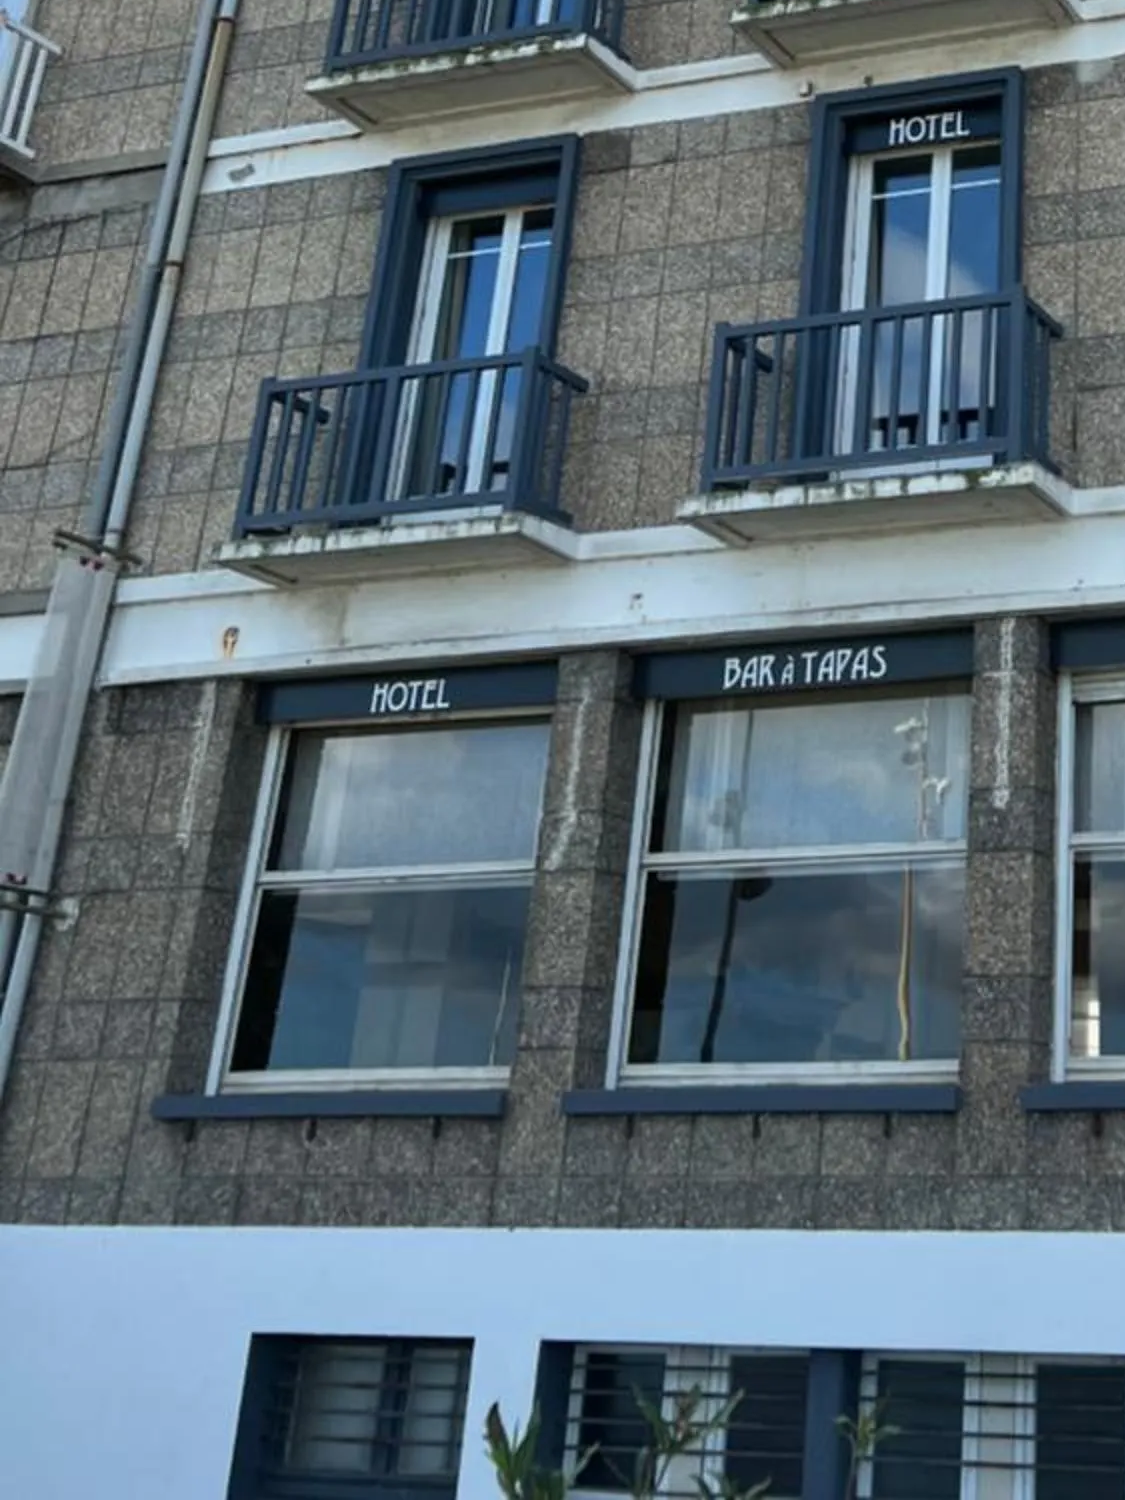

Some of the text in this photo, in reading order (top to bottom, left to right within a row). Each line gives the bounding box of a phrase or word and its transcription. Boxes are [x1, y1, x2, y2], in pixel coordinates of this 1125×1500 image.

[888, 108, 971, 146] HOTEL
[723, 654, 776, 690] BAR
[801, 645, 888, 684] TAPAS
[370, 678, 450, 714] HOTEL
